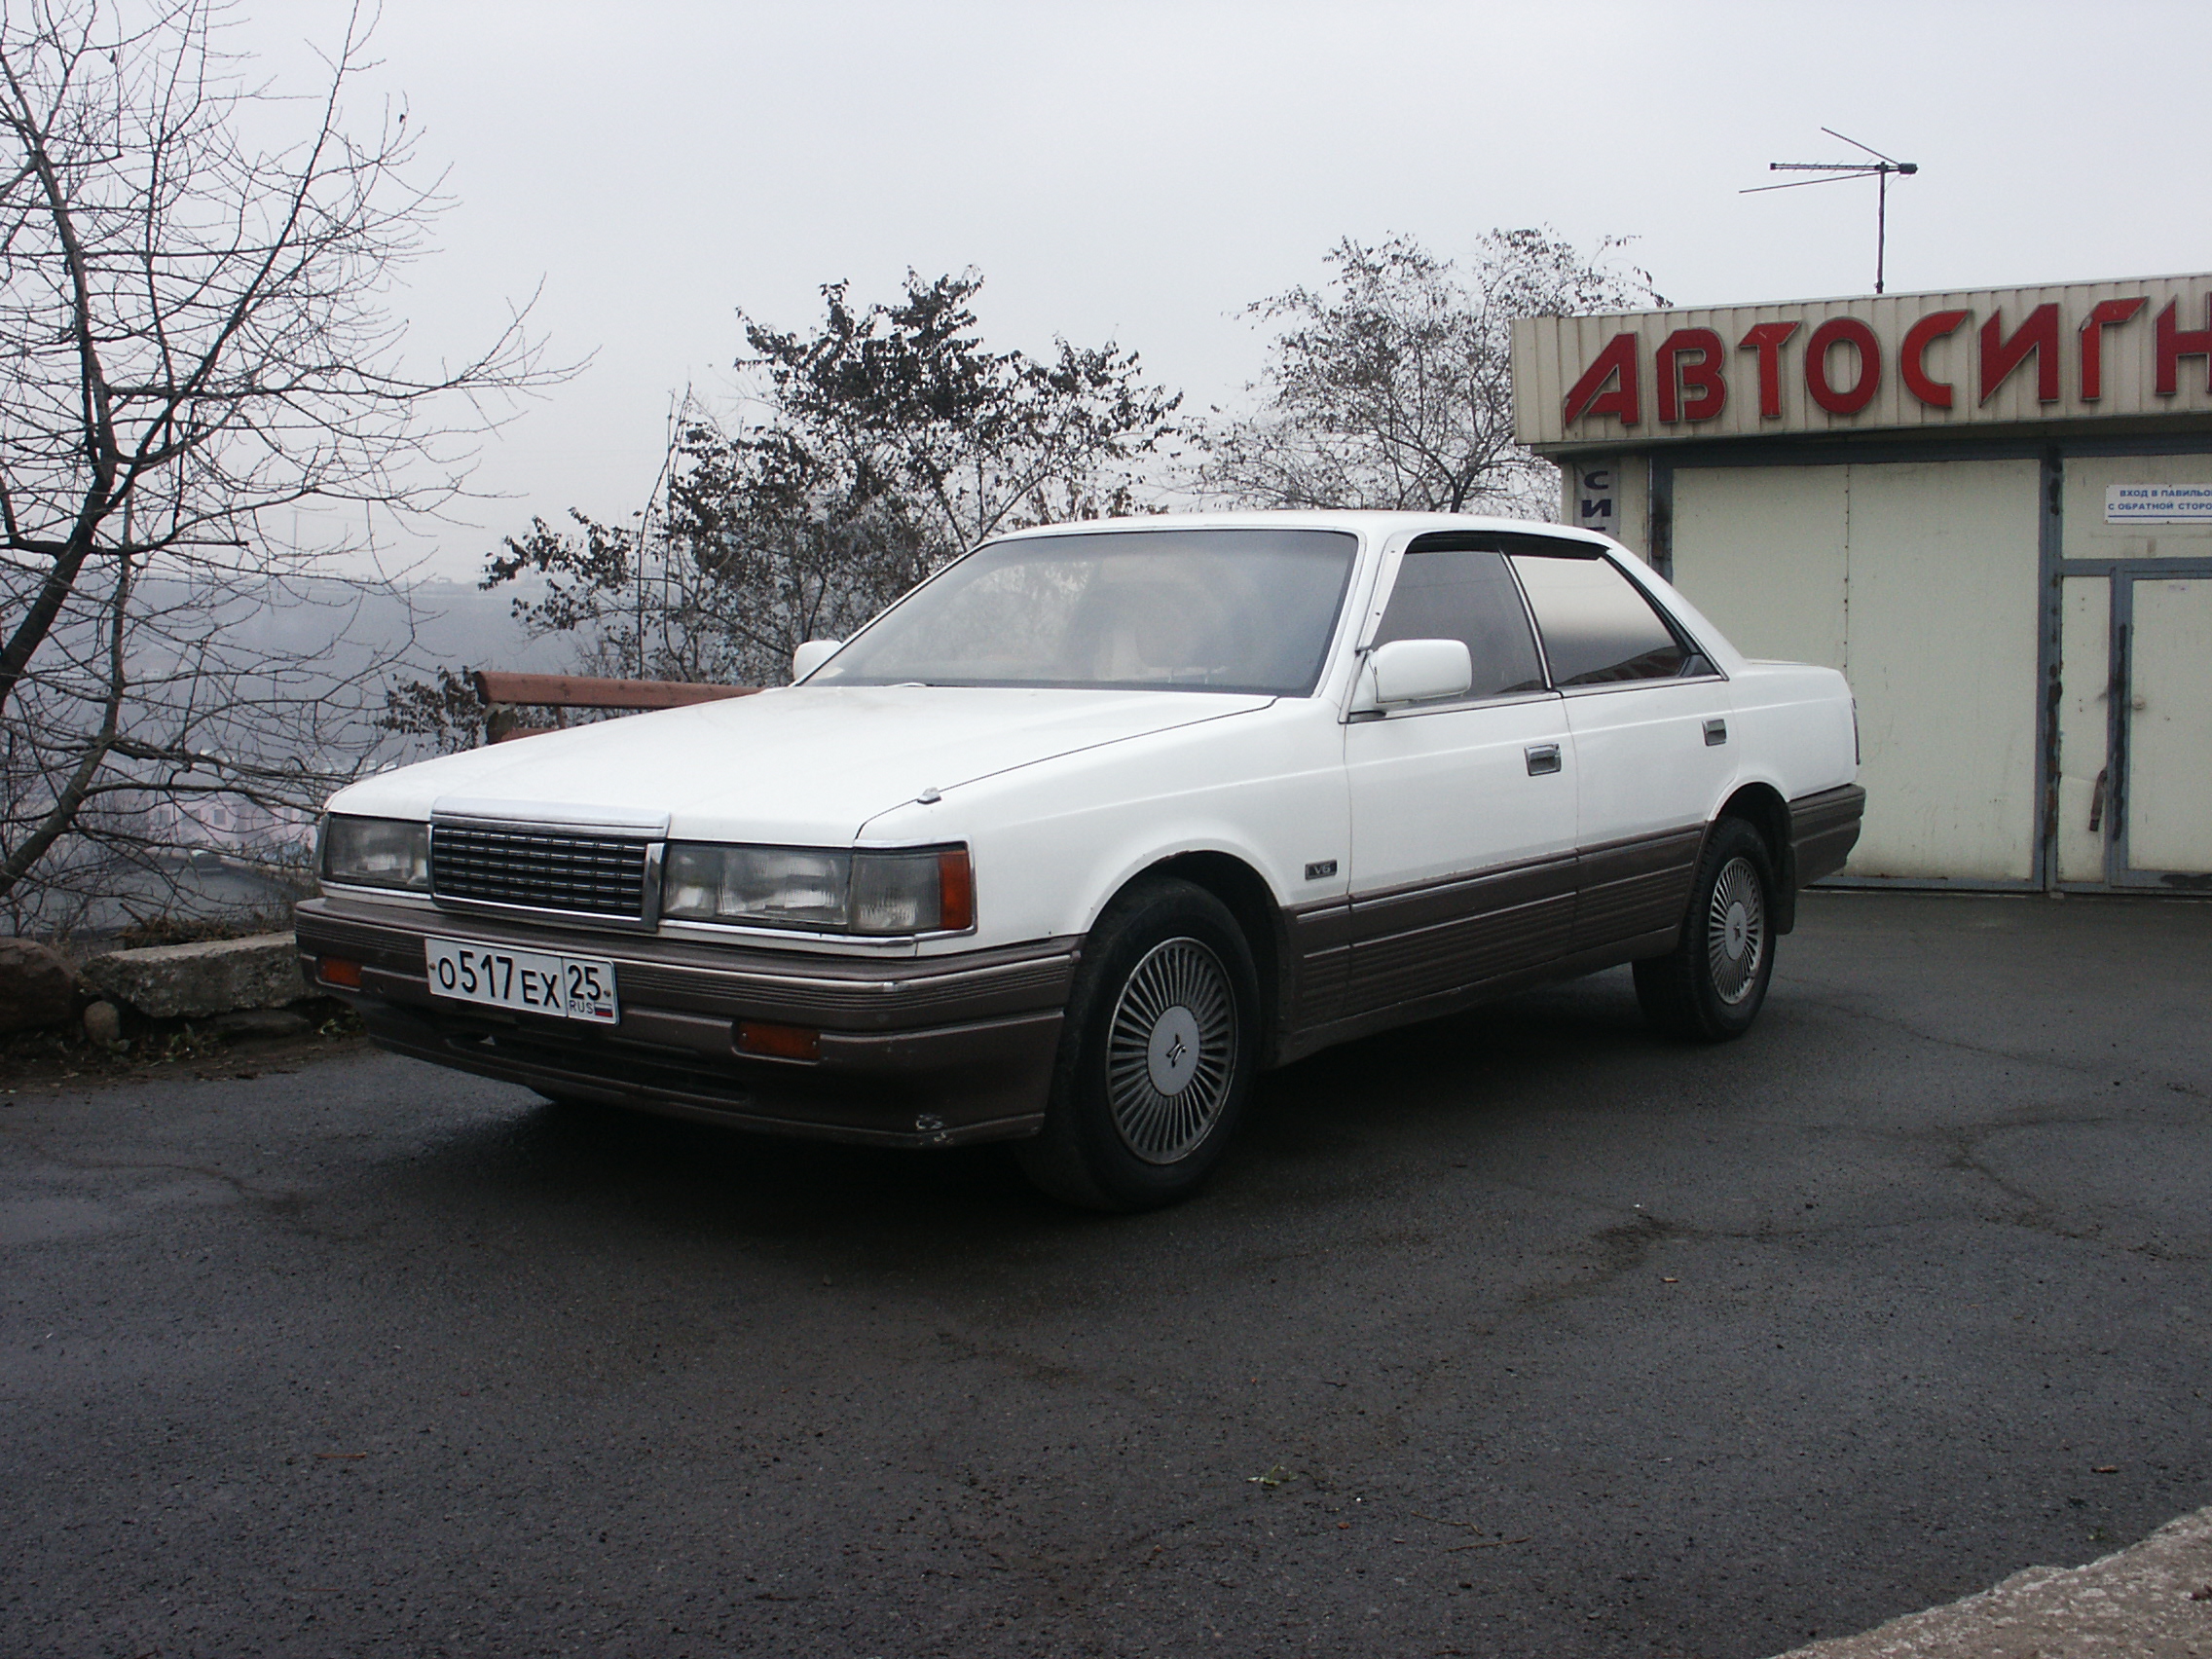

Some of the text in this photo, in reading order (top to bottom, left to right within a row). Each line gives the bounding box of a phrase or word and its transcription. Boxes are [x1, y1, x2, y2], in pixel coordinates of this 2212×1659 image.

[1565, 292, 2212, 425] АВТОСИГН
[1581, 470, 1611, 532] СИ
[568, 964, 602, 1001] 25
[569, 999, 593, 1014] RUS
